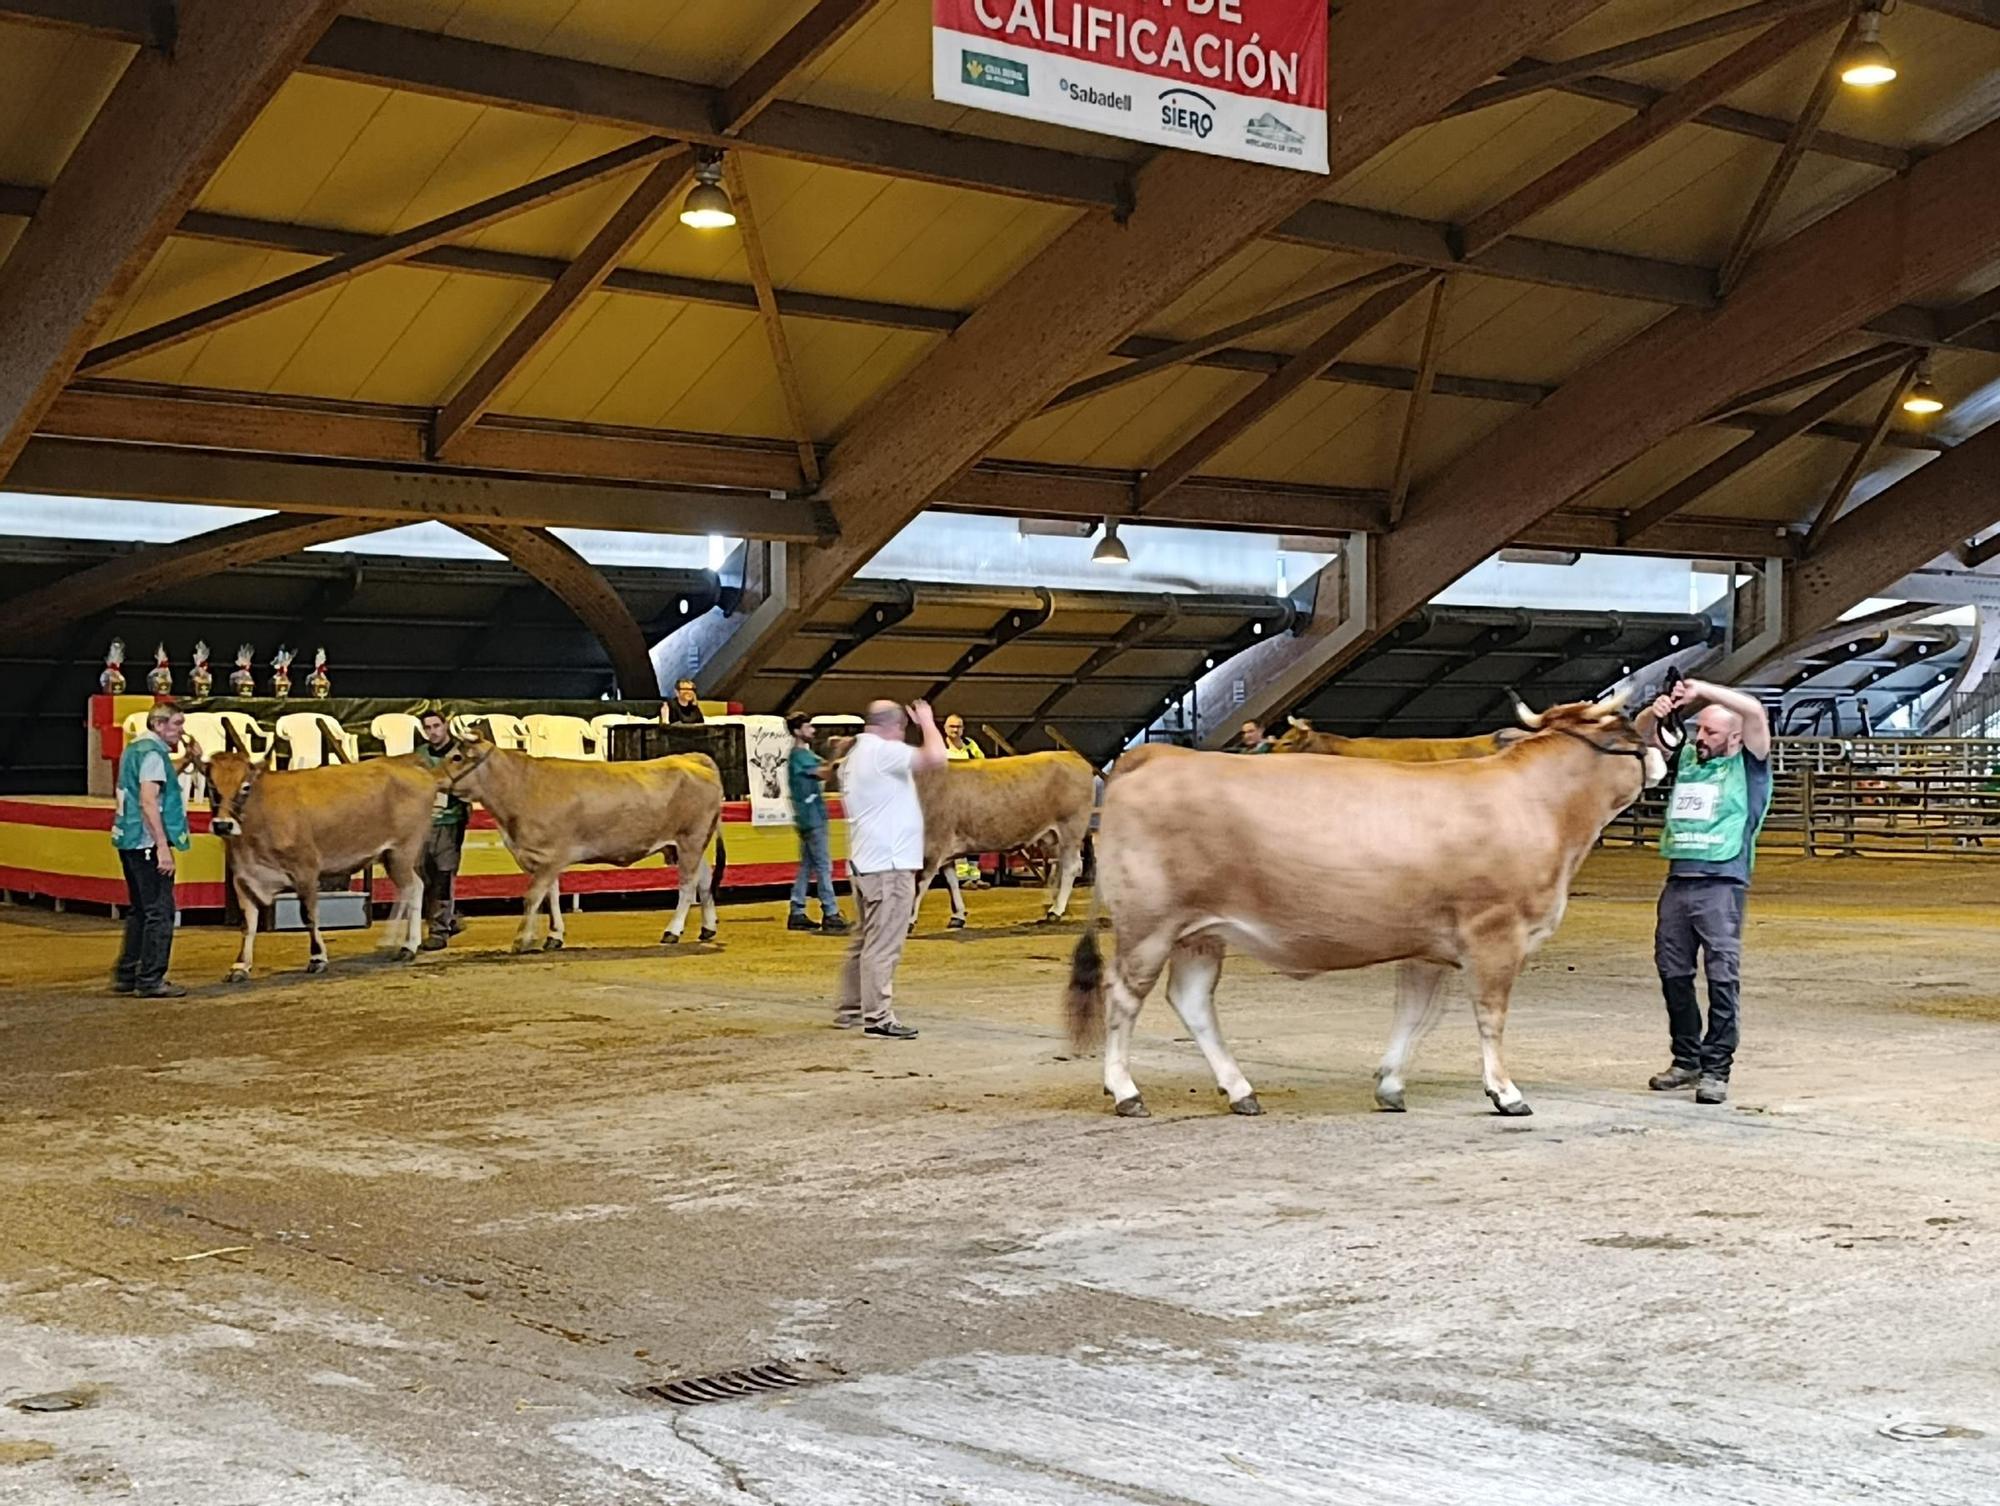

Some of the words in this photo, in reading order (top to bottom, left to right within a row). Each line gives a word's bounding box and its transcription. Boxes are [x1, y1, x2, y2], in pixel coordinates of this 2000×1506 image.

[974, 0, 1298, 95] CALIFICACIÓN
[1069, 83, 1132, 111] Sabadell
[1676, 796, 1703, 810] 279
